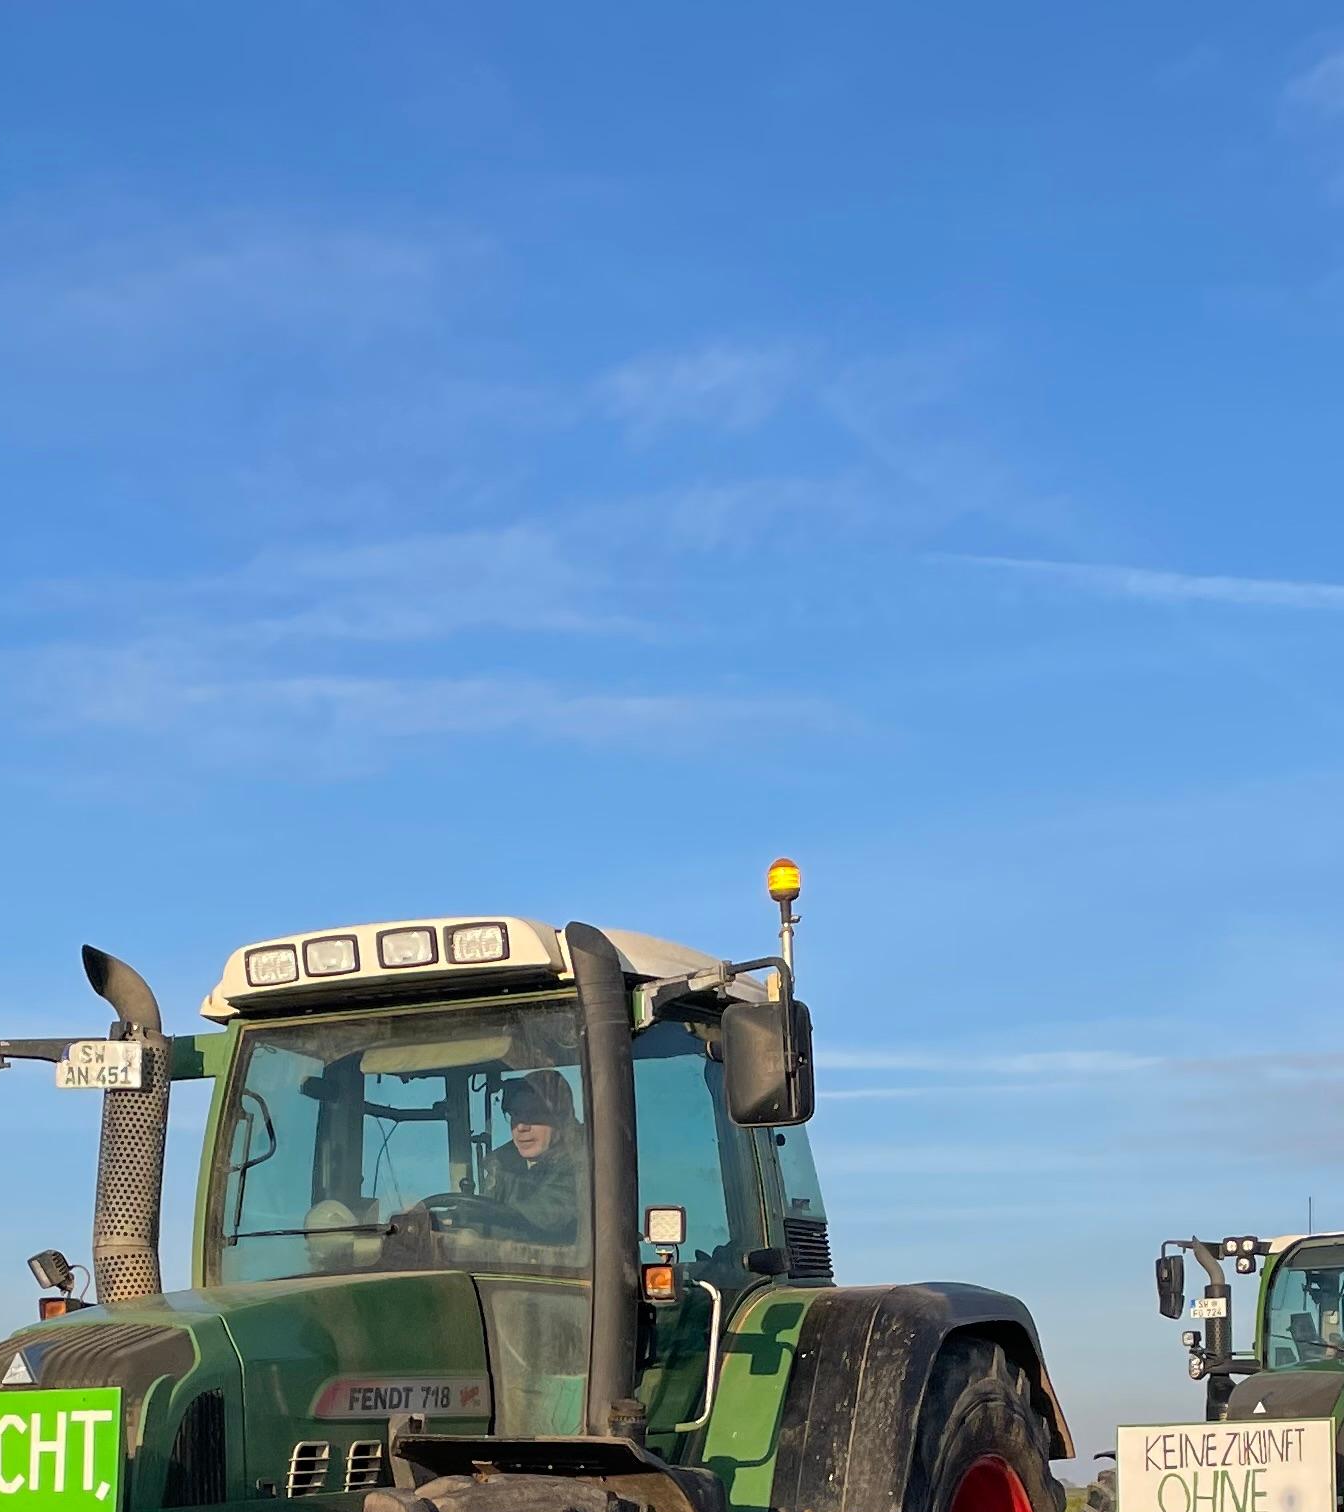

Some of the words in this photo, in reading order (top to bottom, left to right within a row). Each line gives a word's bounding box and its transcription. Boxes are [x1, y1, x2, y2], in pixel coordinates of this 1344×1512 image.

[81, 1045, 105, 1064] SW
[65, 1066, 89, 1085] AN
[96, 1066, 132, 1085] 451
[348, 1387, 413, 1411] FENDT
[421, 1386, 450, 1408] 718
[1145, 1433, 1217, 1471] KEINE
